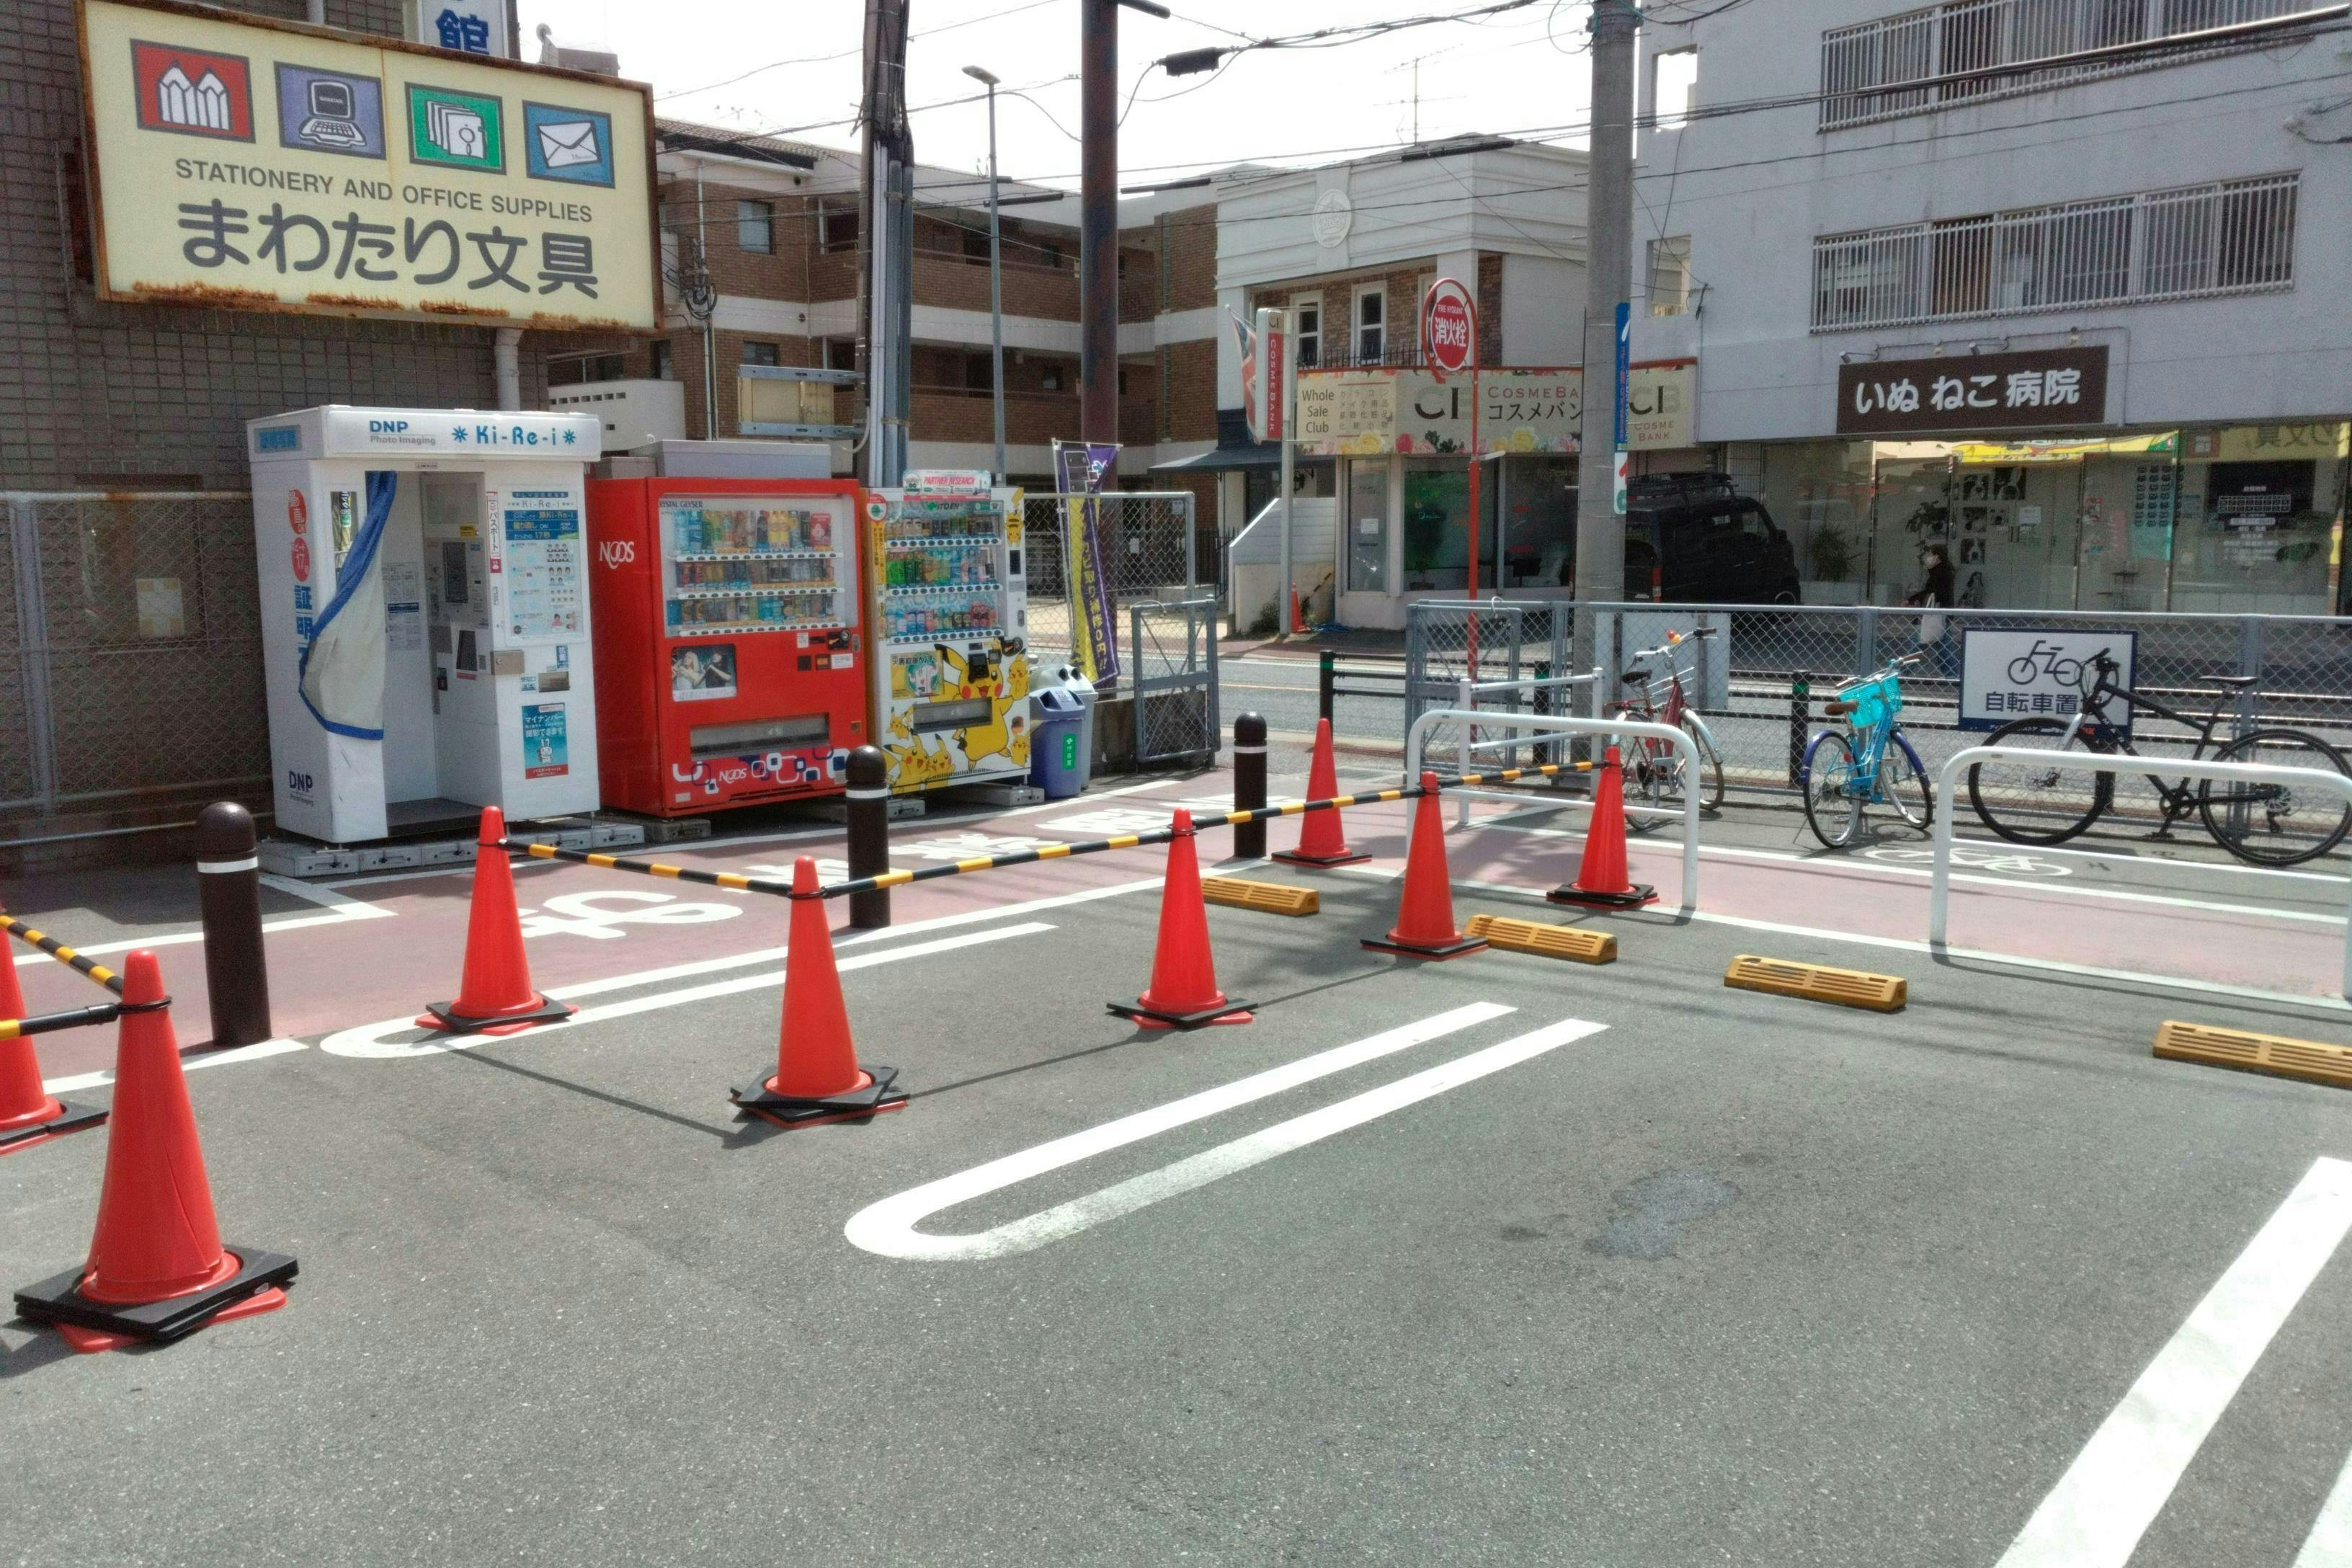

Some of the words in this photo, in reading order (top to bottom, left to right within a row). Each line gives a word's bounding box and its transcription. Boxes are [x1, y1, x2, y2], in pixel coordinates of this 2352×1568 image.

[175, 159, 334, 195] STATIONERY
[344, 179, 393, 201] AND
[403, 184, 483, 211] OFFICE
[491, 195, 592, 223] SUPPLIES
[178, 198, 598, 300] まわたり文具
[1438, 305, 1446, 313] FIRE
[1447, 306, 1464, 315] HYDRANT
[1435, 316, 1466, 347] 消火栓
[1301, 389, 1335, 401] Whole
[1856, 378, 1920, 414] いぬ
[1930, 375, 1998, 411] ねこ
[2006, 368, 2081, 408] 病院
[1307, 406, 1329, 417] Sale
[370, 420, 409, 432] DNP
[1306, 422, 1329, 433] Club
[1634, 420, 1675, 430] COSME
[370, 435, 396, 444] Photo
[398, 436, 436, 446] Imaging
[476, 425, 556, 445] Ki-Re-i
[1639, 432, 1670, 442] BANK
[924, 476, 946, 485] PARTNER
[949, 476, 975, 485] RESEARCH
[599, 540, 635, 569] NOOS
[1986, 691, 2085, 715] 自転車置
[525, 715, 565, 724] マイナンバー
[289, 770, 313, 792] DNP
[719, 768, 747, 784] NOOS
